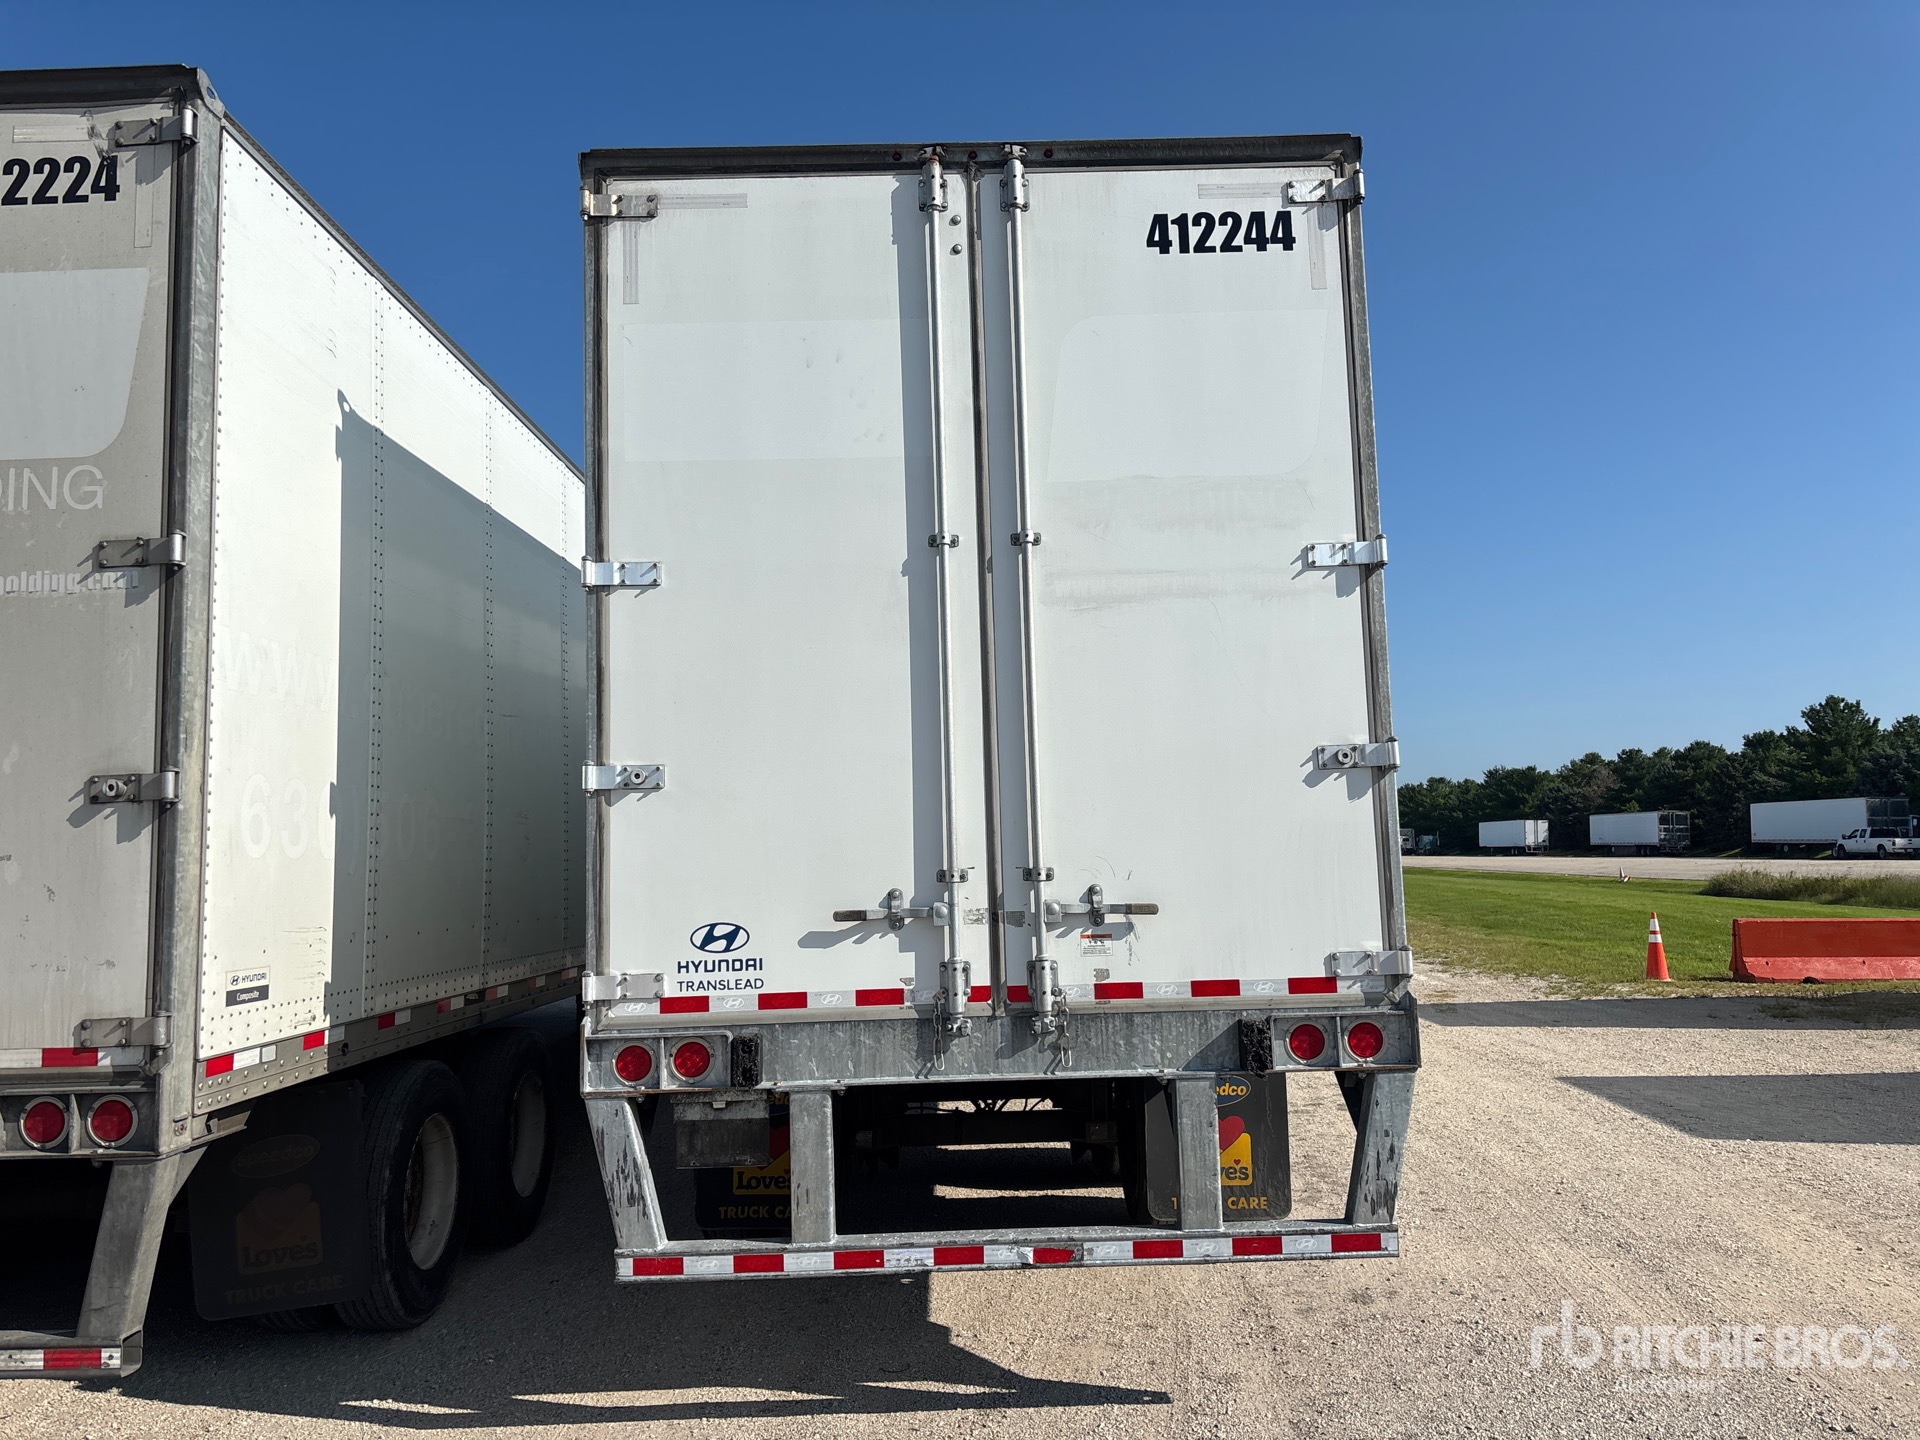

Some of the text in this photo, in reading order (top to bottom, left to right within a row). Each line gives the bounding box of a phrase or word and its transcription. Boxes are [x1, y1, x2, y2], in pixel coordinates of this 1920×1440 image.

[1, 155, 121, 206] 2224
[1146, 211, 1297, 255] 412244
[0, 464, 104, 511] ING
[0, 570, 139, 596] olding.com
[677, 957, 763, 974] HYUNDAI
[241, 972, 267, 983] HYUNDAI
[676, 977, 764, 993] TRANSLEAD
[1227, 1196, 1268, 1210] CARE
[718, 1206, 770, 1220] TRUCK
